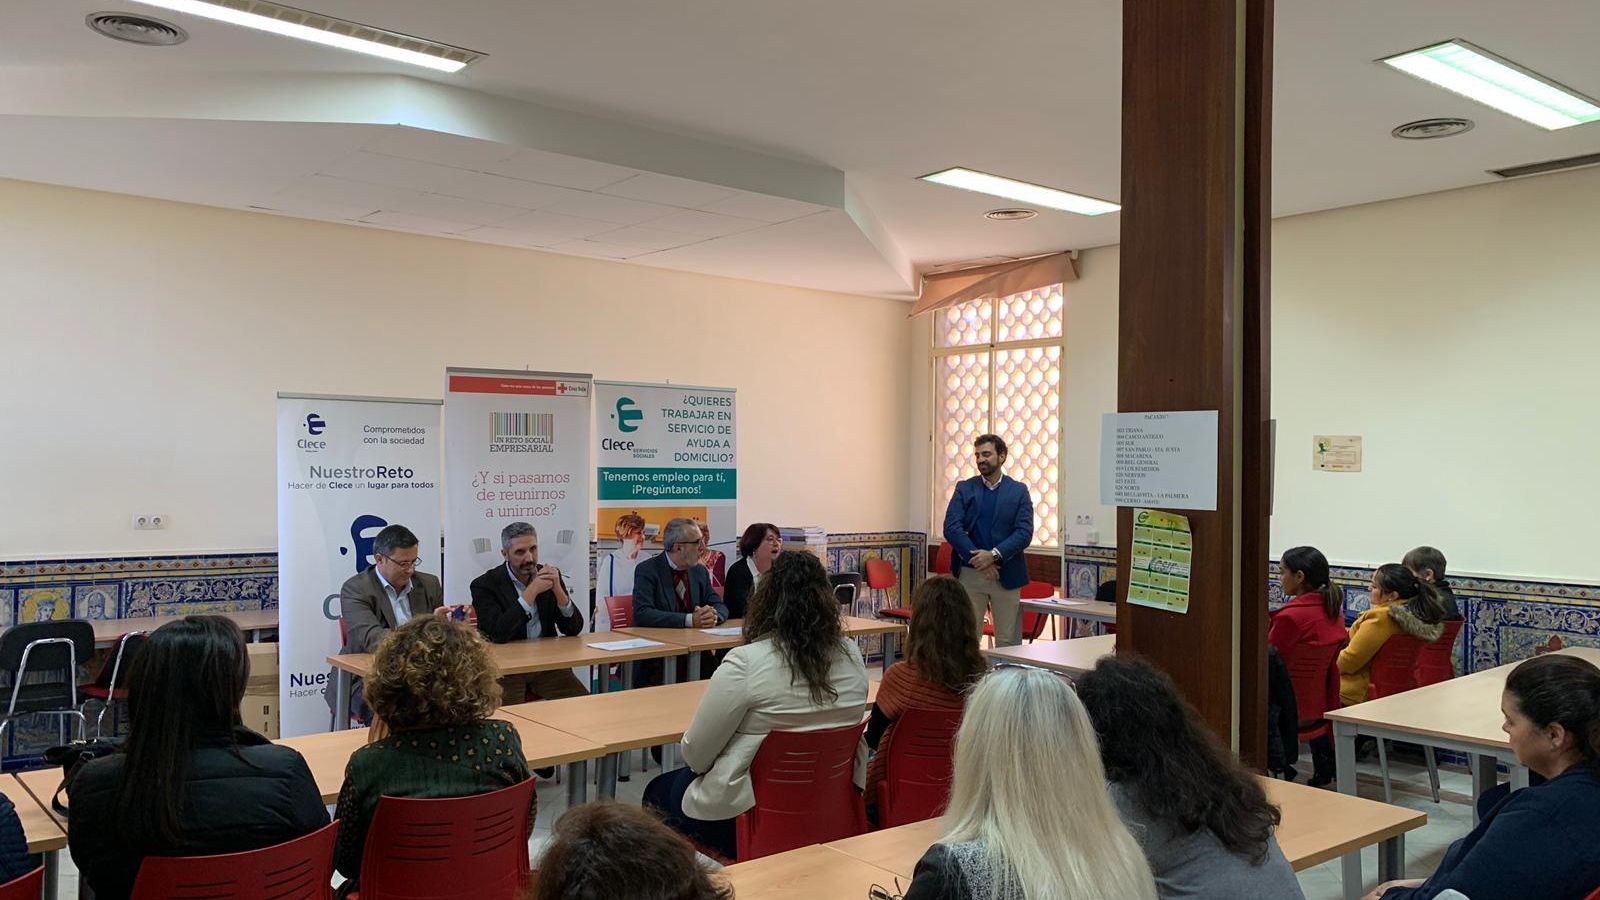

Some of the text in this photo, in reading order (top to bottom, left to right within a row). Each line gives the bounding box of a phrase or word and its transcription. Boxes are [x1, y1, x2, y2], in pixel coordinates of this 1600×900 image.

[683, 395, 732, 406] ¿QUIERES
[662, 409, 731, 420] TRABAJAR EN
[364, 424, 426, 434] Comprometidos
[668, 424, 731, 434] SERVICIO DE
[297, 439, 326, 449] Clece
[490, 445, 553, 453] EMPRESARIAL
[602, 438, 634, 450] Clece
[686, 439, 730, 449] AYUDA A
[674, 453, 734, 463] DOMICILIO?
[472, 471, 570, 488] ¿Y si pasamos
[603, 471, 649, 482] Tenemos
[652, 472, 690, 483] empleo
[693, 474, 713, 483] para
[368, 482, 388, 491] lugar
[632, 485, 701, 496] ¡Pregúntanos!
[477, 488, 566, 501] de reunirnos
[486, 503, 557, 518] a unirnos?
[290, 688, 317, 698] Hacer
